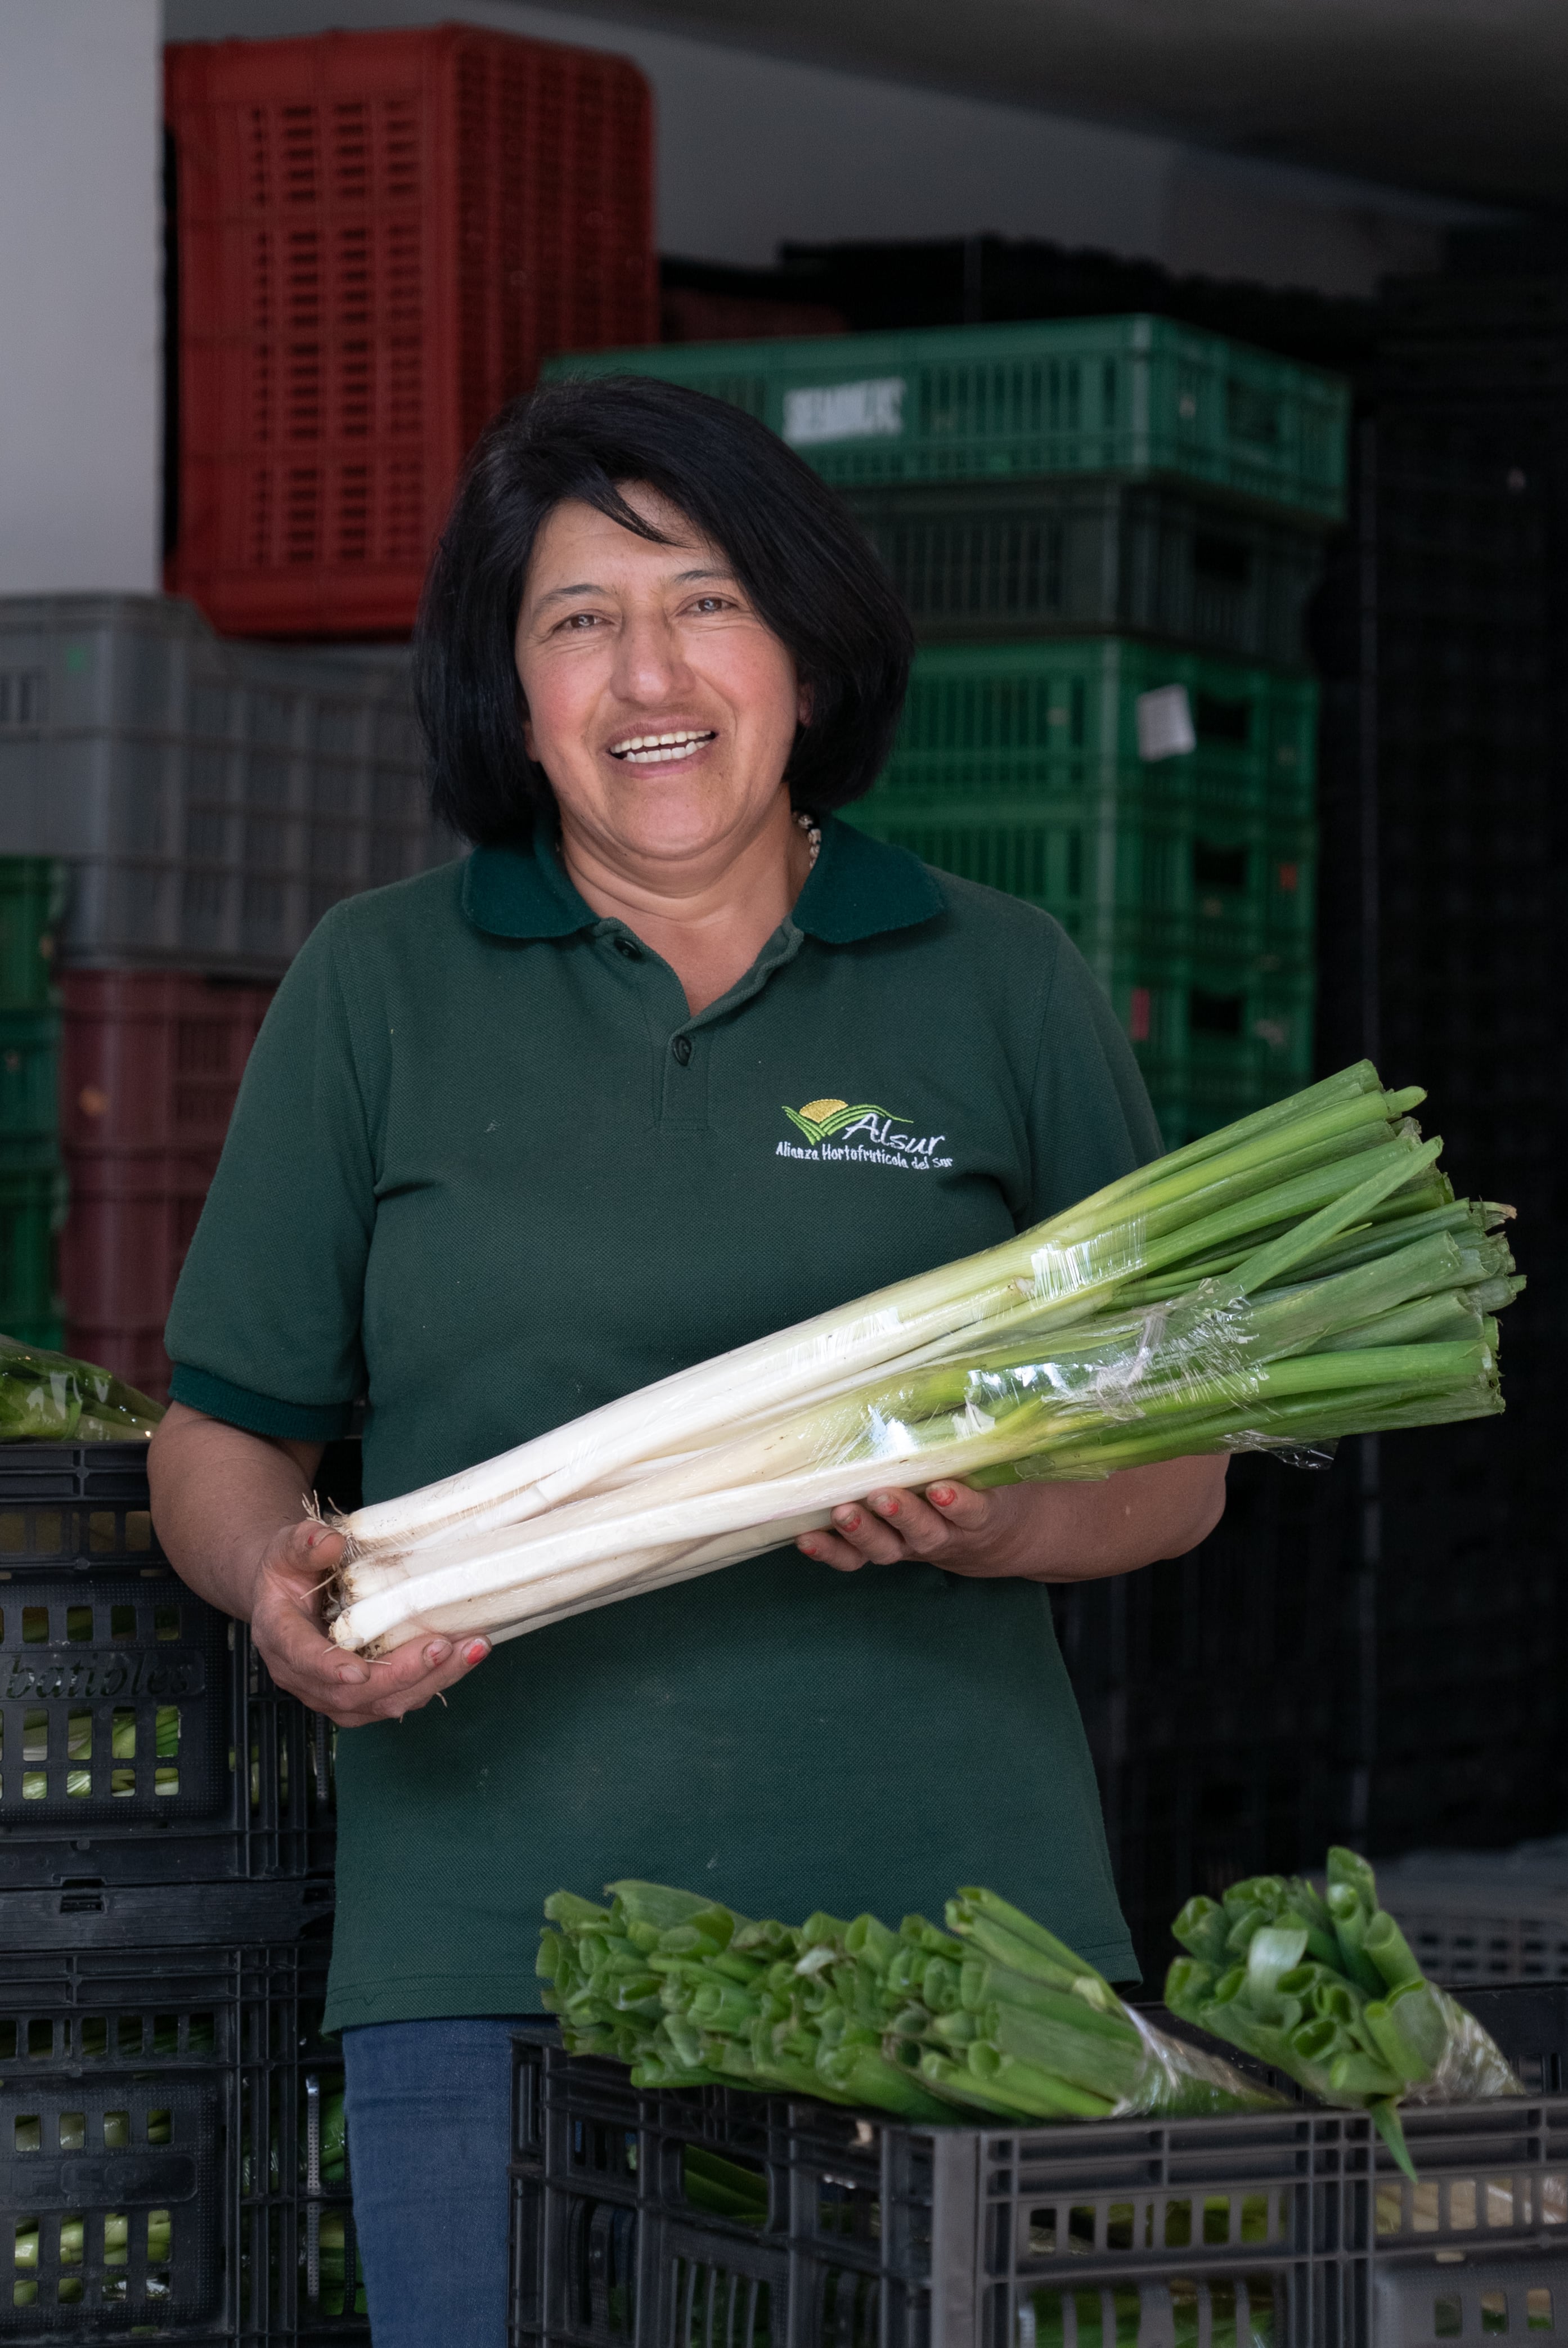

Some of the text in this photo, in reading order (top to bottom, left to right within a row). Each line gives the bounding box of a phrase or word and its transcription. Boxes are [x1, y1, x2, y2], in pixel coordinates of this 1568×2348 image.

[842, 1113, 945, 1156] Alsur
[776, 1142, 819, 1161] Alianza
[911, 1156, 929, 1170] del
